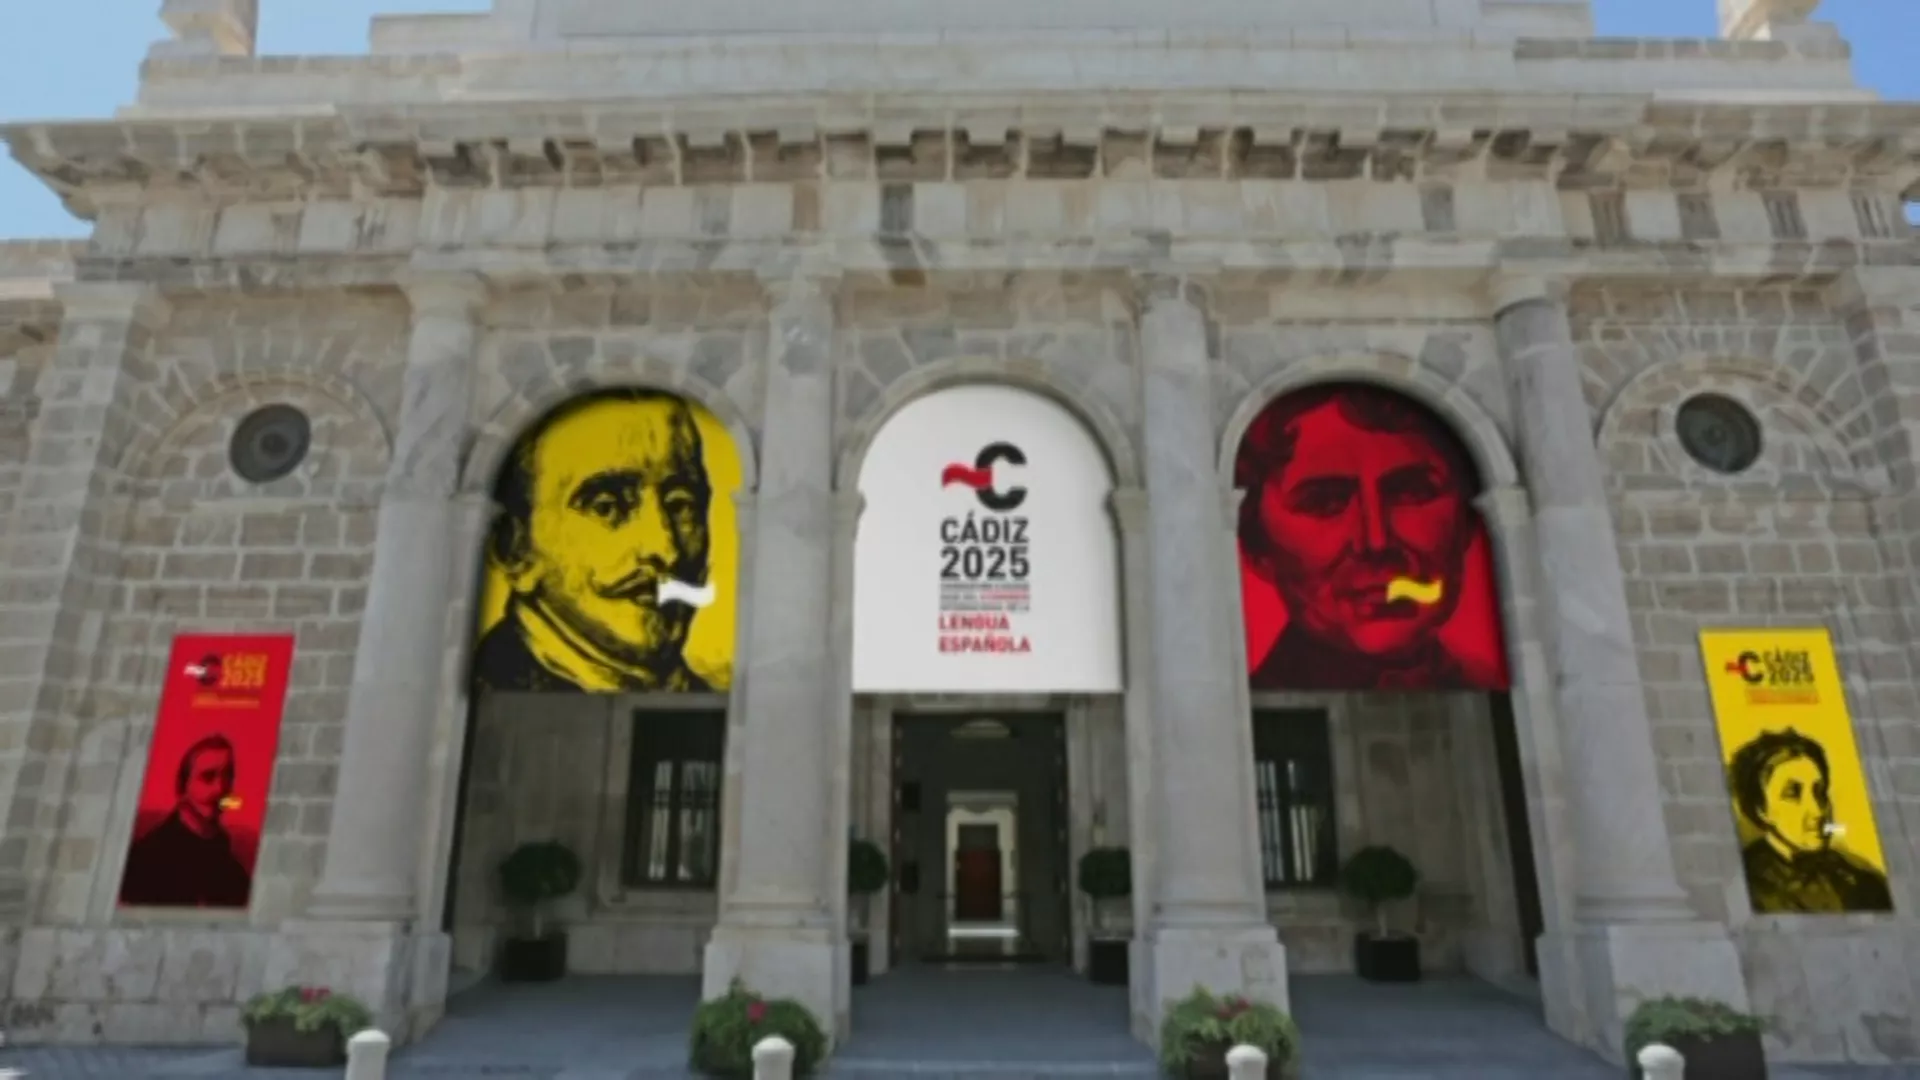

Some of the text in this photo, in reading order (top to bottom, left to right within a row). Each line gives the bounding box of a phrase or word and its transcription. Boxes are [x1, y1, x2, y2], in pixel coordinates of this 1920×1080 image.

[940, 510, 1030, 543] CÁDIZ
[940, 546, 1030, 579] 2025
[938, 613, 1010, 631] LENGUA
[938, 633, 1031, 653] ESPAÑOLA
